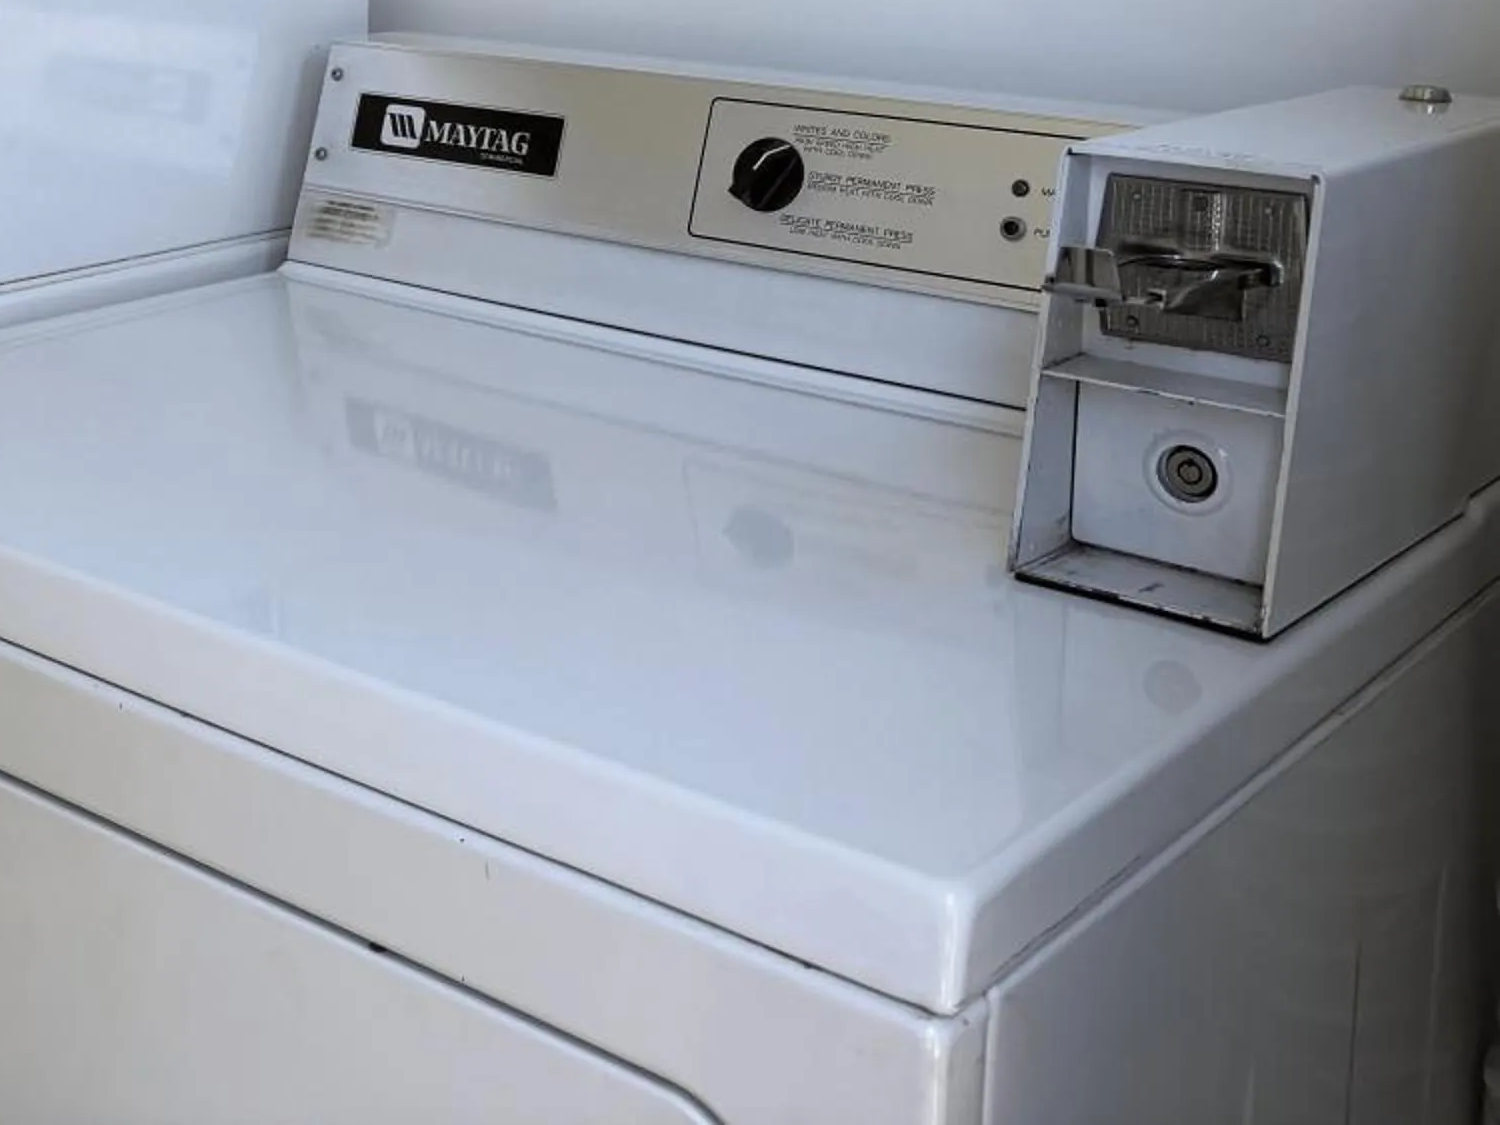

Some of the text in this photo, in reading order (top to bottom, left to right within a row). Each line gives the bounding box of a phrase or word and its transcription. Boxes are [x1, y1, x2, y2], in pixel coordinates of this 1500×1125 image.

[425, 120, 531, 156] MAYTAG
[830, 128, 851, 138] AND
[845, 176, 901, 190] PERMANENT
[905, 183, 936, 196] PRESS
